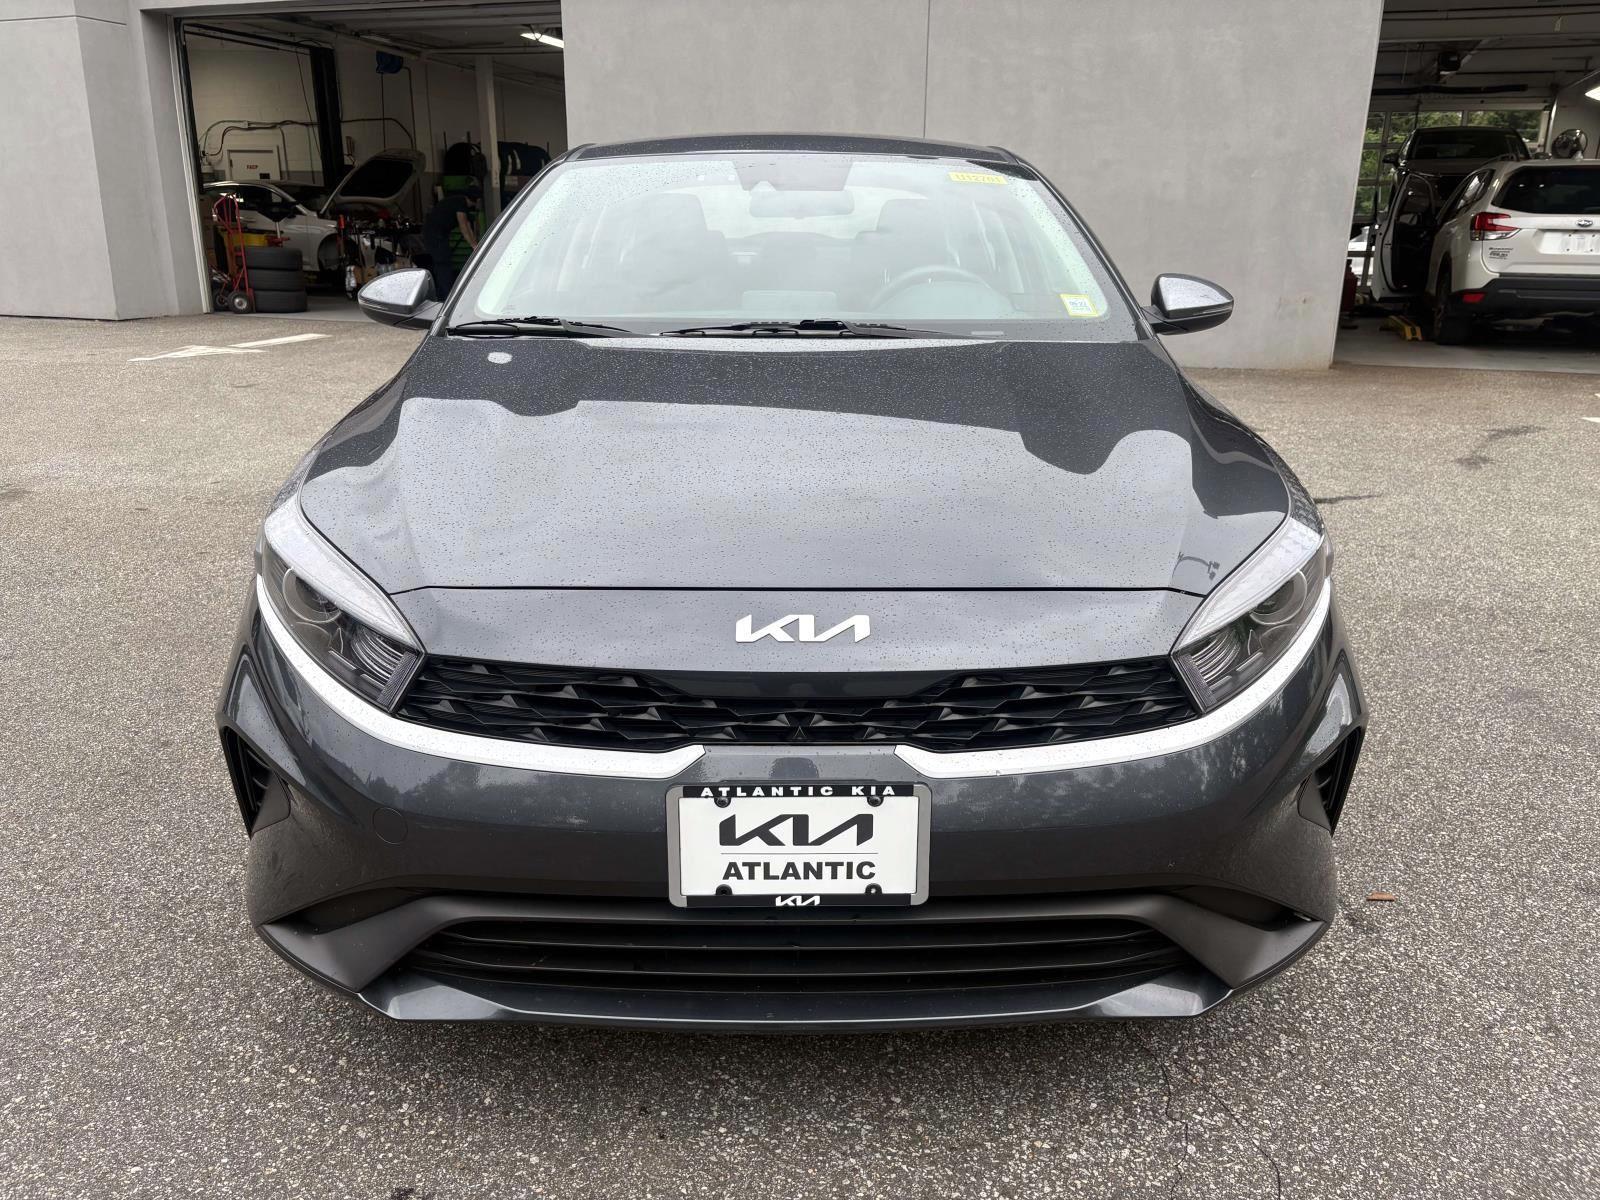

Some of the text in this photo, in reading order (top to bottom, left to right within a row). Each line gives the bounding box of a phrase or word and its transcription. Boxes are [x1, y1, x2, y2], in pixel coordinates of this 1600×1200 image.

[735, 614, 871, 643] KIA
[700, 785, 896, 797] ATLANTIC KIA
[719, 813, 874, 846] KIA
[722, 861, 876, 881] ATLANTIC
[775, 895, 821, 907] KIA
